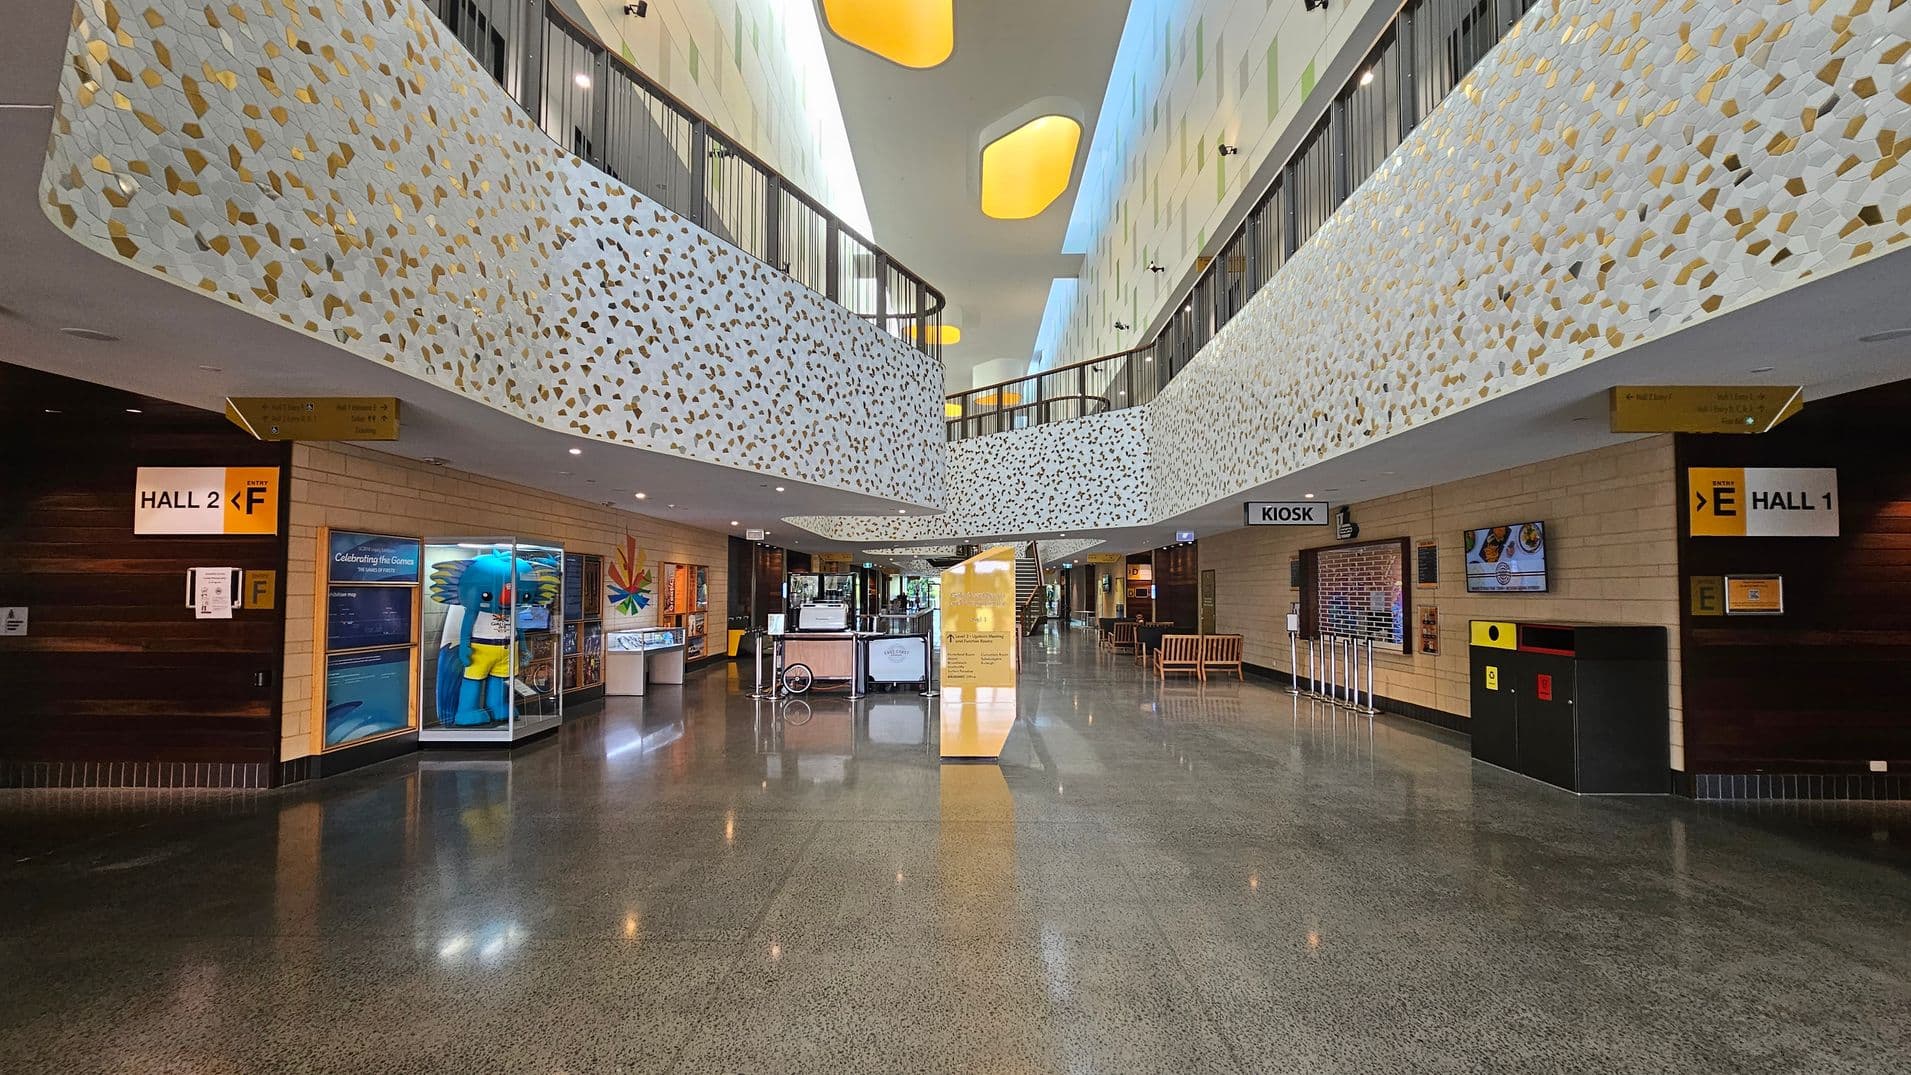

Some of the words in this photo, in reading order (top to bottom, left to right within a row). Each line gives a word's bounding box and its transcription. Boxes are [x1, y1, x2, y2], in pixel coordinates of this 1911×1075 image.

[141, 491, 200, 509] HALL
[207, 491, 220, 509] 2
[246, 487, 267, 515] F
[1713, 487, 1736, 516] E
[1752, 491, 1815, 510] HALL
[1821, 492, 1832, 510] 1
[1262, 507, 1314, 521] KIOSK
[335, 552, 379, 566] Celebrating
[379, 555, 391, 564] the
[391, 556, 415, 566] Games
[253, 580, 268, 605] F
